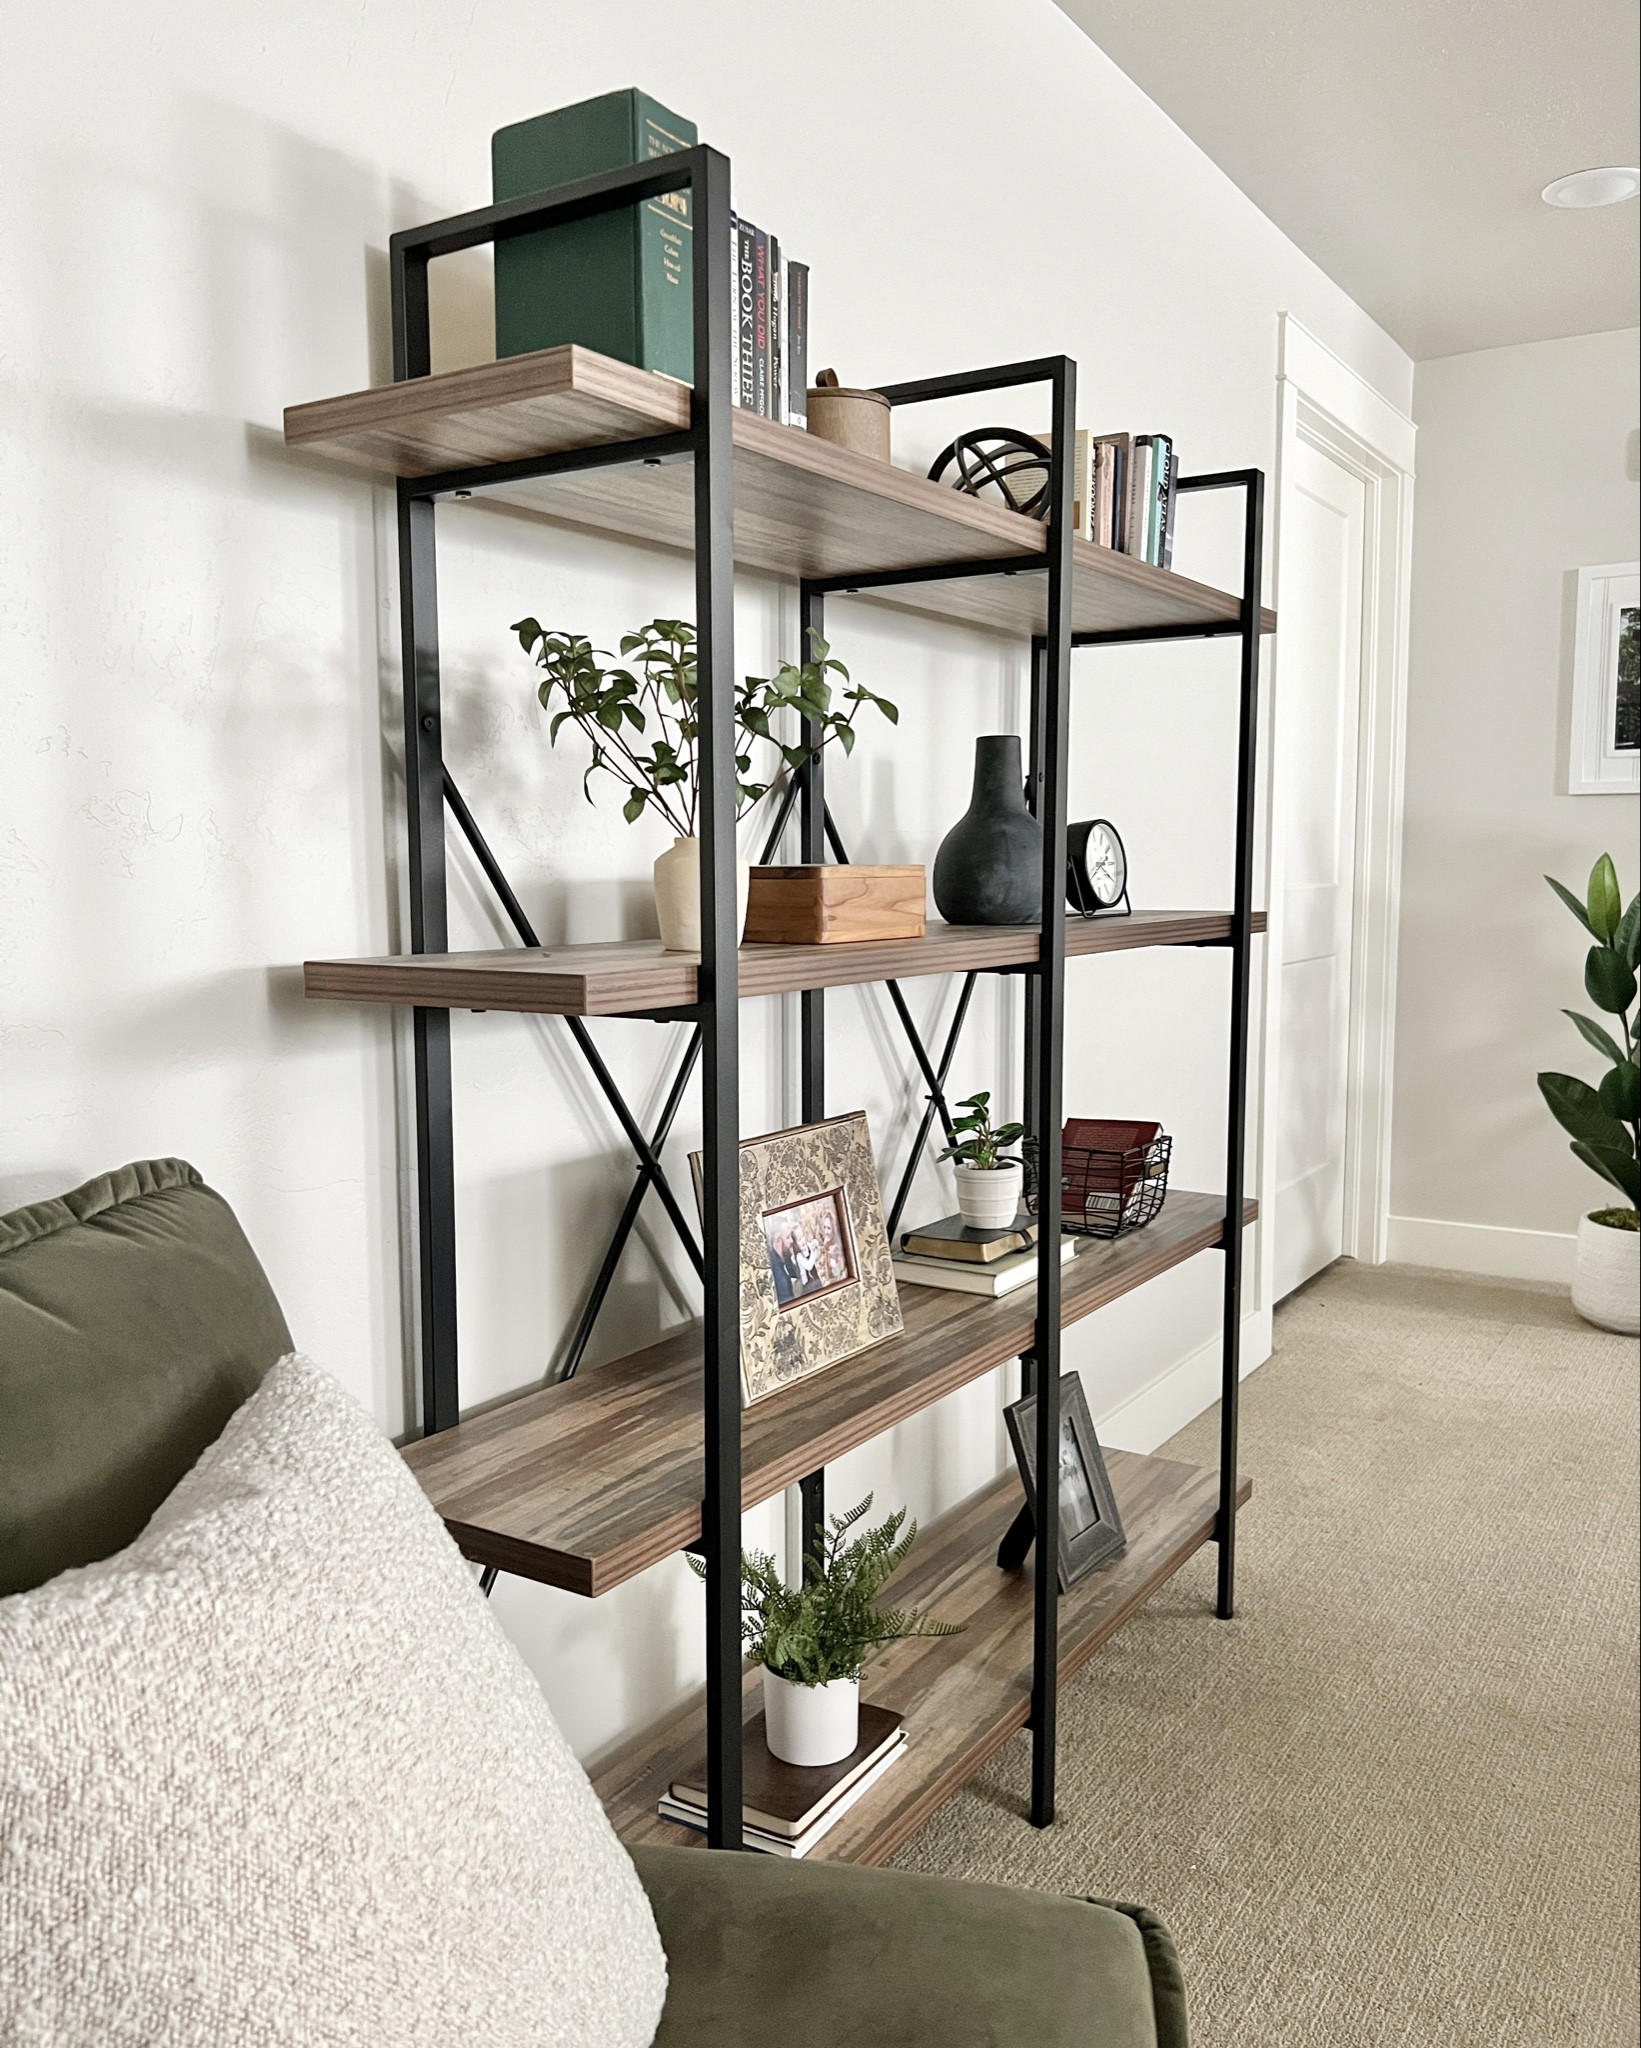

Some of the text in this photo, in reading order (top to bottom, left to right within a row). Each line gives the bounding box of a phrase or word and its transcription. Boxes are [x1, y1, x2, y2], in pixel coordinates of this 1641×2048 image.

[742, 259, 753, 328] BOOK
[757, 245, 765, 350] WHAT YOU DID
[742, 334, 753, 405] THIEF
[1160, 442, 1171, 533] CLOUD ATLAS
